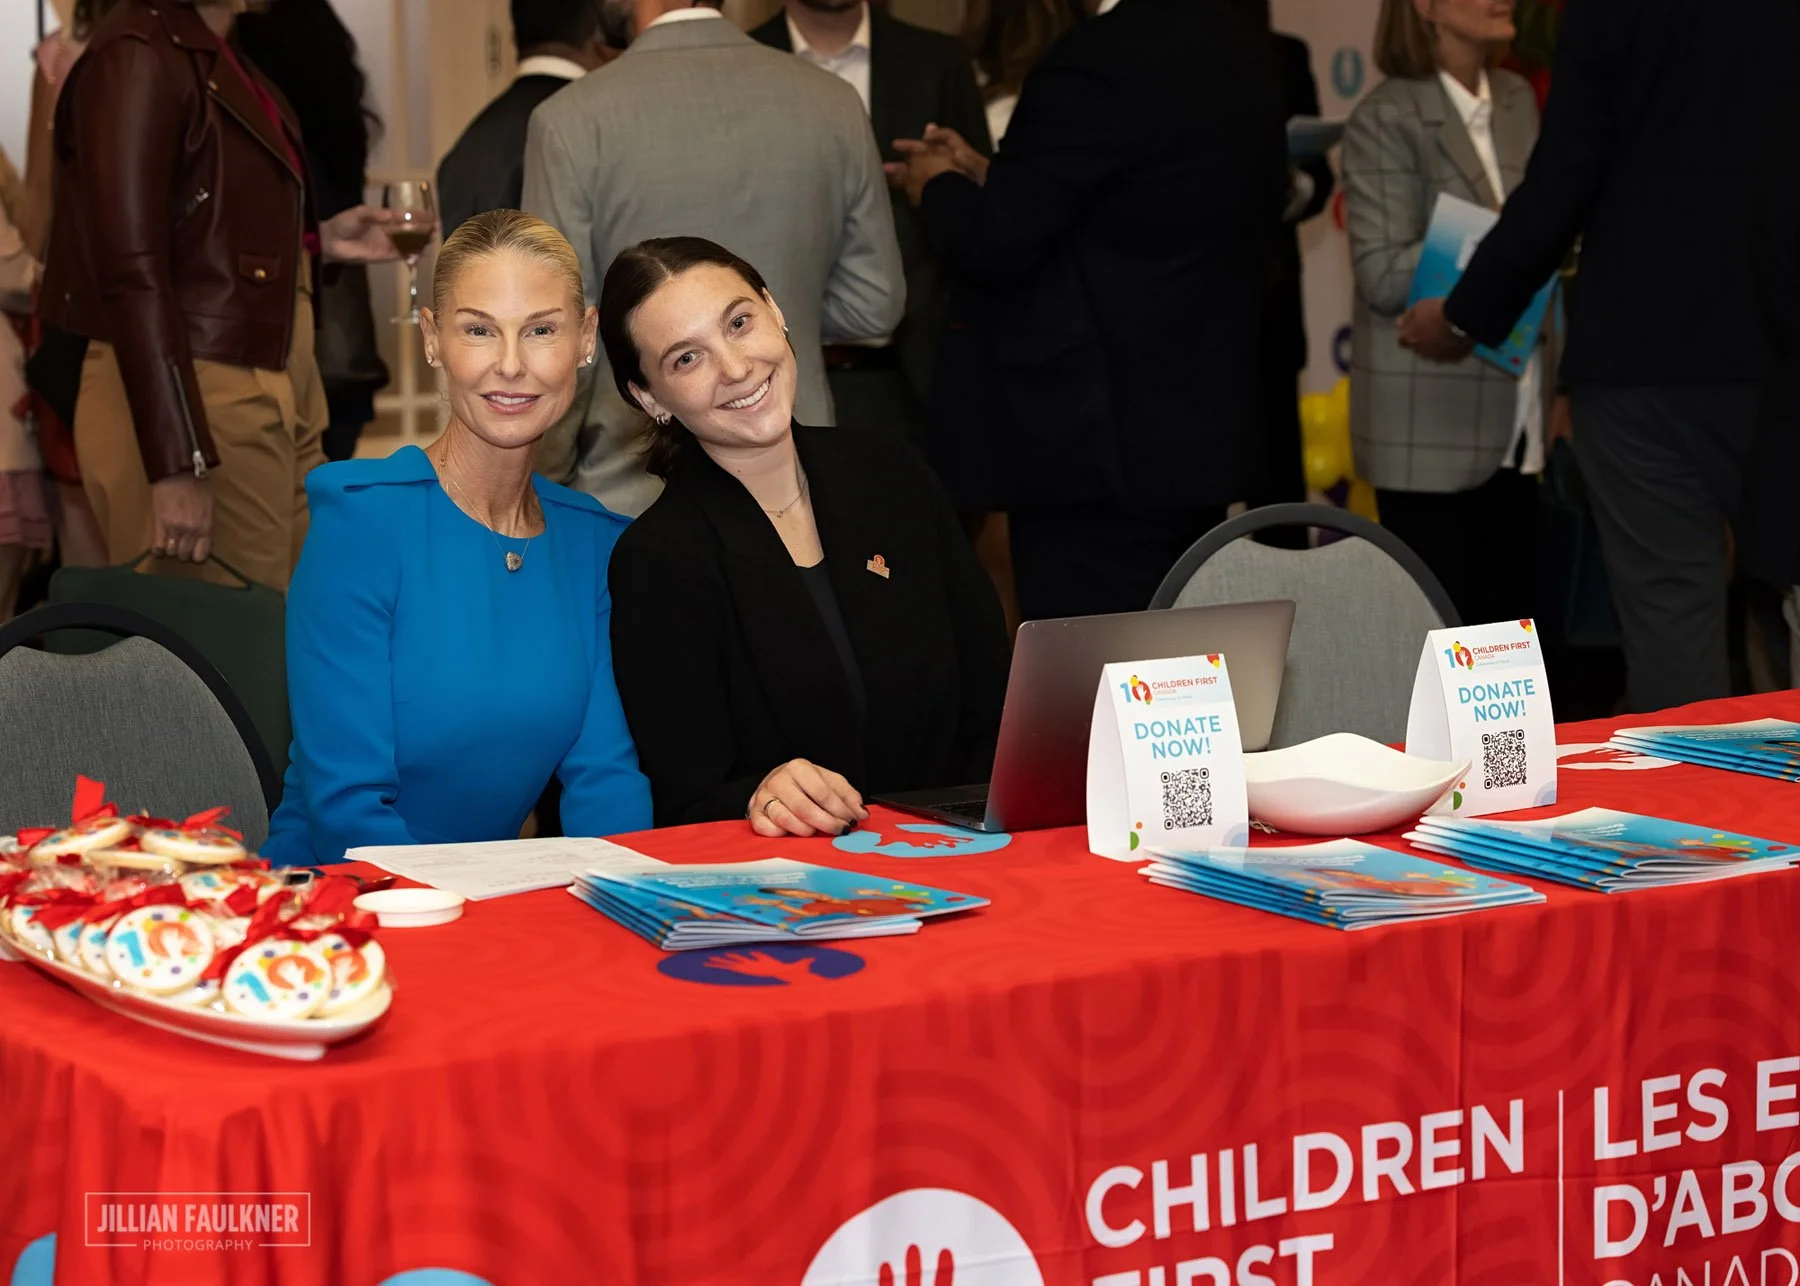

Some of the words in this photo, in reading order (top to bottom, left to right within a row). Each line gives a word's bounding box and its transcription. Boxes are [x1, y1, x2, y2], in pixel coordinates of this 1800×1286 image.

[1472, 644, 1509, 655] CHILDREN
[1510, 641, 1531, 650] FIRST
[1152, 679, 1194, 689] CHILDREN
[1195, 677, 1218, 686] FIRST
[1458, 679, 1535, 704] DONATE
[1474, 700, 1526, 722] NOW!
[1134, 715, 1222, 740] DONATE
[1152, 738, 1211, 759] NOW!
[1594, 1068, 1729, 1161] LES
[1085, 1098, 1525, 1249] CHILDREN
